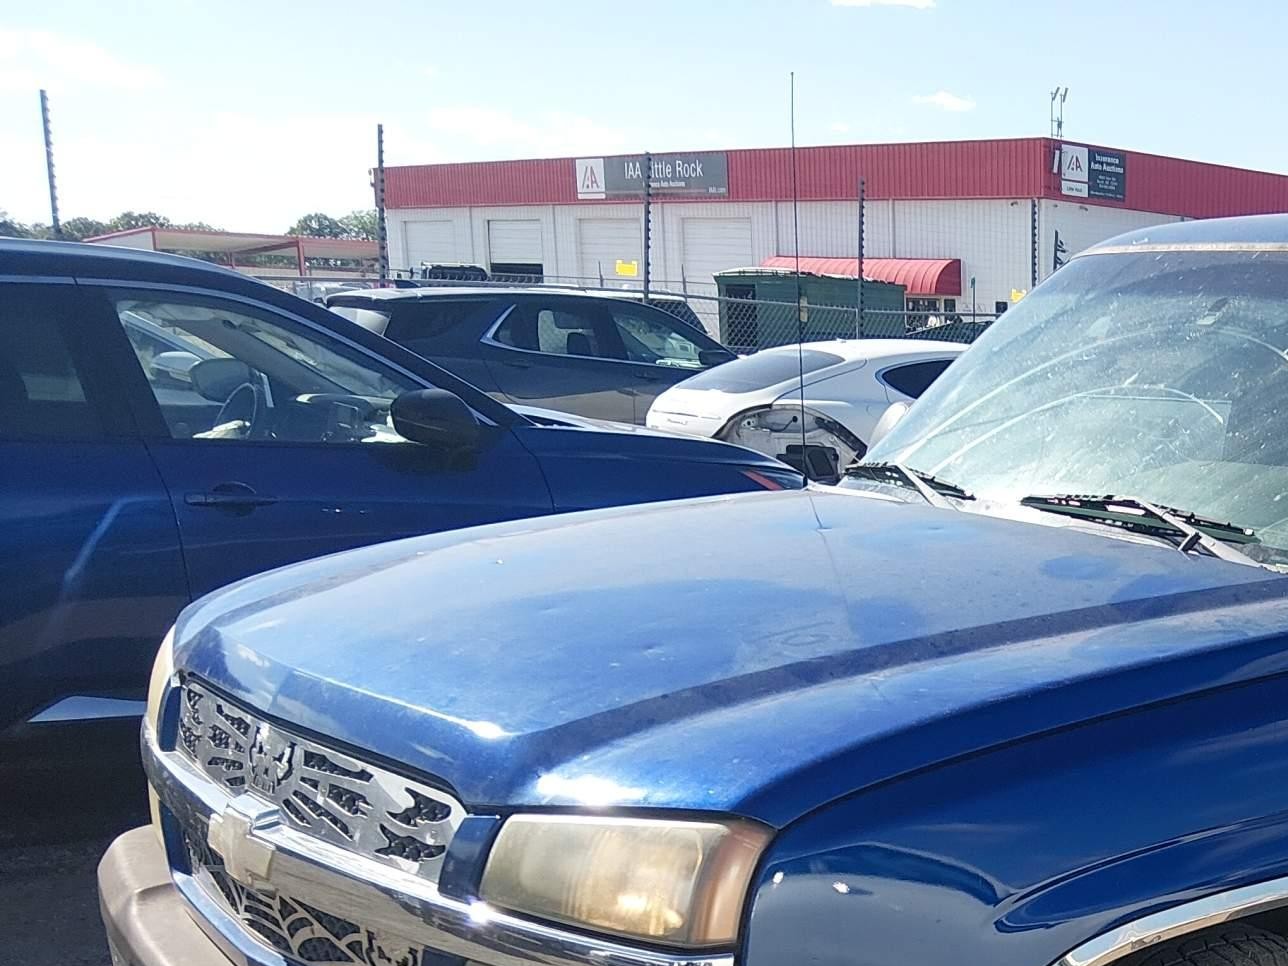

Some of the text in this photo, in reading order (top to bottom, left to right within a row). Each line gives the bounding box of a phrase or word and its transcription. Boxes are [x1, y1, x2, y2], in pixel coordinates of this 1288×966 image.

[625, 159, 704, 179] IAA ittle Rock
